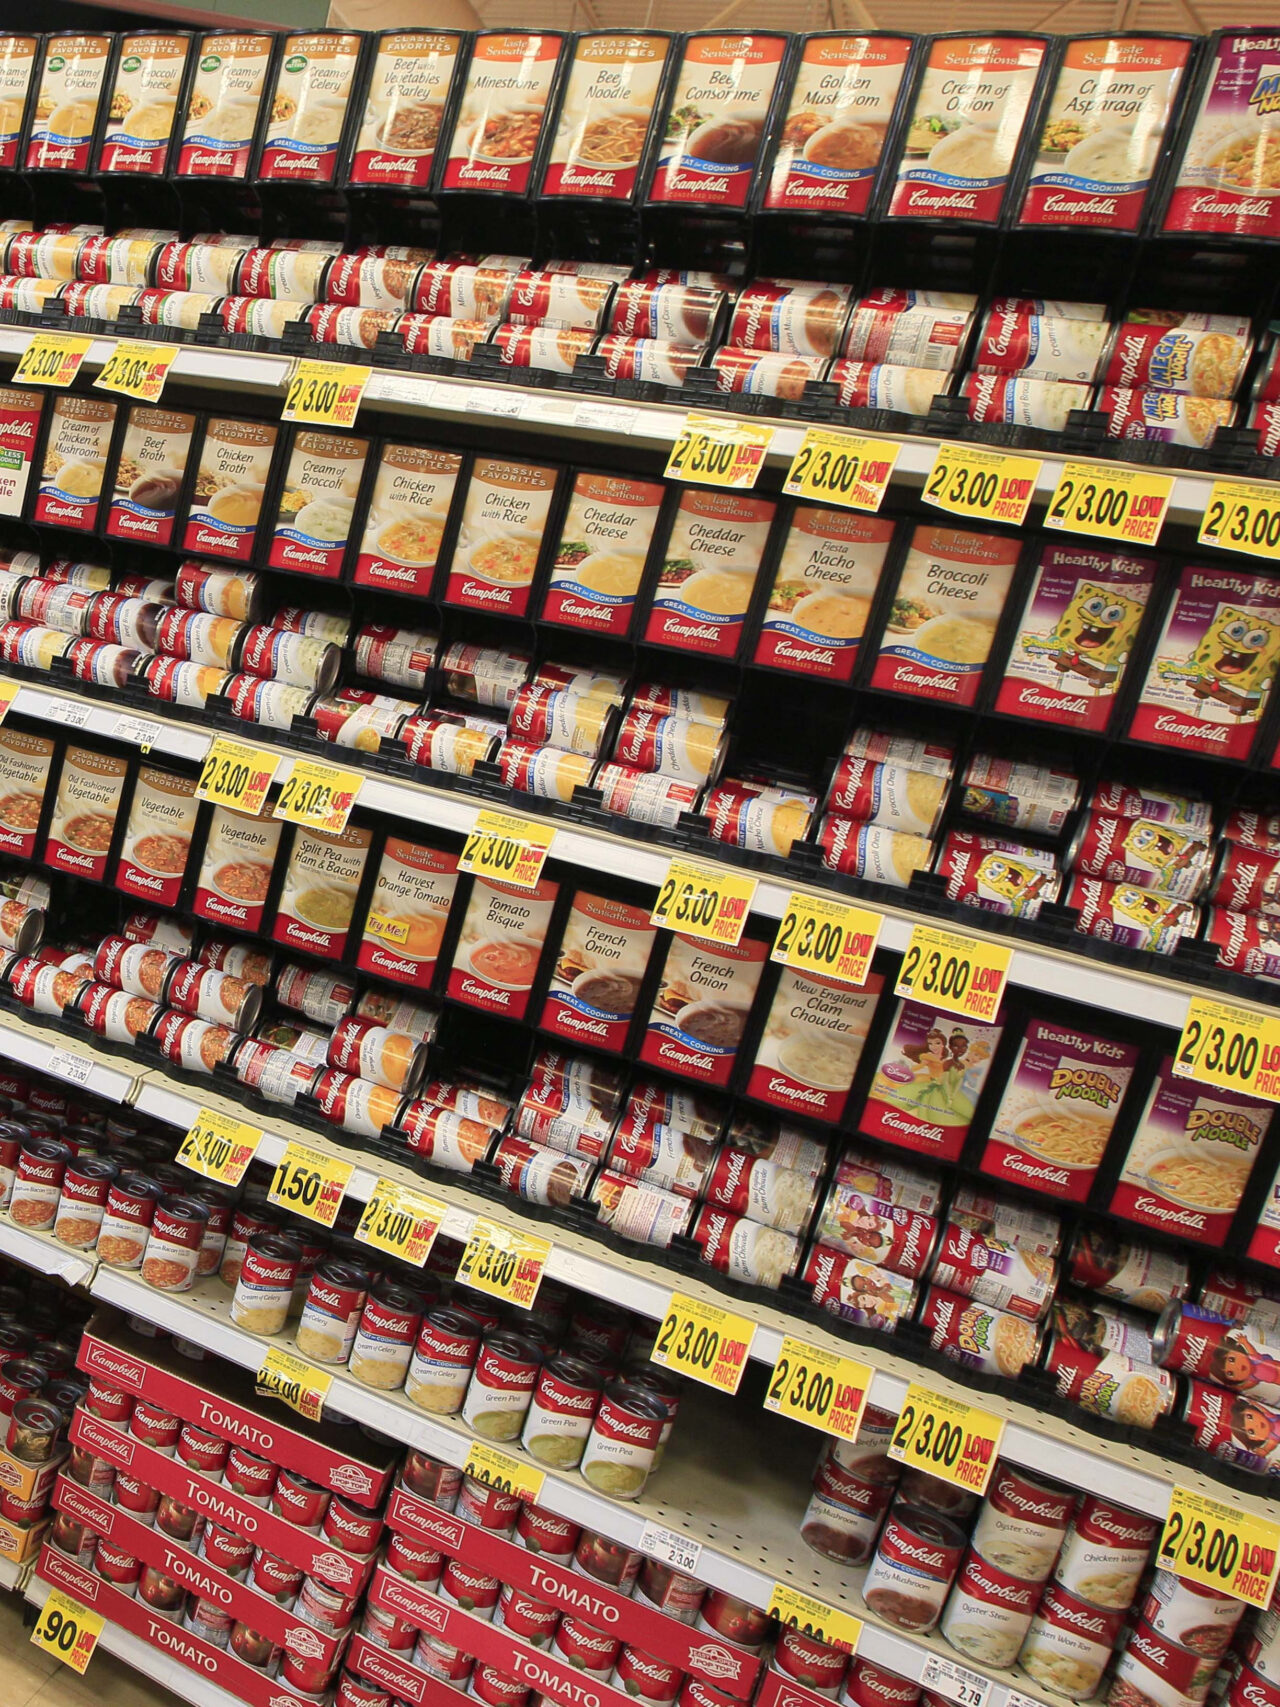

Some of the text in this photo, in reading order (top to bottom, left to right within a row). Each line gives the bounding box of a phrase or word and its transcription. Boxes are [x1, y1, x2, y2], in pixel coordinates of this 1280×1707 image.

[311, 76, 341, 94] Celery
[338, 69, 350, 80] of
[585, 84, 631, 100] Noodle
[274, 137, 328, 153] GREAT COOKING
[909, 169, 989, 189] GREAT COOKING
[287, 378, 338, 412] 2/3.00
[59, 430, 90, 445] Chicken
[62, 420, 101, 436] Cream of
[4, 449, 20, 459] LESS
[54, 443, 100, 458] Mushroom
[144, 437, 167, 449] Beef
[140, 448, 166, 463] Broth
[216, 448, 254, 463] Chicken
[218, 459, 246, 474] Broth
[303, 460, 347, 478] Cream of
[481, 470, 547, 488] FAVORITES
[488, 463, 542, 478] CLASSIC
[790, 446, 860, 492] 2/3.00
[860, 459, 891, 484] LOW
[301, 472, 343, 490] Broccoli
[485, 493, 530, 511] Chicken
[1051, 480, 1128, 526] 2/3.00
[1130, 495, 1165, 518] LOW
[481, 507, 528, 524] with Rice
[584, 508, 637, 526] Cheddar
[585, 522, 628, 540] Cheese
[1122, 519, 1157, 540] PRICE!
[822, 541, 849, 553] Fiesta
[809, 551, 855, 570] Nacho
[1054, 552, 1144, 575] Healthy Kids
[804, 564, 852, 584] Cheese
[927, 565, 989, 587] Broccoli
[560, 582, 622, 604] GREAT COOKING
[927, 581, 978, 601] Cheese
[10, 756, 43, 773] Fashioned
[199, 757, 249, 798] 2/3.00
[248, 769, 272, 791] LOW
[142, 798, 185, 820] Vegetable
[240, 791, 260, 811] PRICE!
[300, 840, 361, 867] Split Pea with
[295, 851, 359, 879] Ham Bacon
[512, 862, 538, 883] PRICE!
[398, 869, 435, 890] Harvest
[378, 876, 450, 907] Orange Tomato
[657, 878, 718, 927] 2/3.00
[489, 897, 530, 918] Tomato
[718, 896, 748, 920] LOW
[386, 921, 408, 937] Me!
[486, 911, 525, 931] Bisque
[712, 919, 738, 940] PRICE!
[586, 925, 627, 947] French
[777, 913, 843, 963] 2/3.00
[584, 940, 621, 960] Onion
[900, 946, 970, 999] 2/3.00
[792, 979, 868, 1009] New England
[558, 992, 618, 1020] GREAT COOKING
[806, 996, 843, 1016] Clam
[789, 1007, 852, 1034] Chowder
[1037, 1026, 1125, 1059] Healthy Kids
[1179, 1020, 1259, 1081] 2/3.00
[1049, 1068, 1121, 1101] DOUBLE
[1056, 1083, 1110, 1109] NOODLE
[274, 1160, 320, 1207] 1.50
[319, 1179, 345, 1203] LOW
[314, 1200, 336, 1223] PRICE!
[658, 1314, 719, 1371] 2/3.00
[718, 1337, 747, 1367] LOW
[710, 1365, 737, 1391] PRICE!
[199, 1400, 274, 1450] TOMATO
[596, 1441, 634, 1456] Green Pea
[186, 1480, 259, 1533] TOMATO
[996, 1520, 1047, 1538] Oyster Stew
[1162, 1512, 1239, 1579] 2/3.00
[1240, 1543, 1275, 1577] LOW
[530, 1565, 619, 1623] TOMATO
[1232, 1571, 1266, 1601] PRICE!
[36, 1610, 77, 1651] .90
[147, 1620, 218, 1673] TOMATO
[957, 1684, 982, 1706] 2.79
